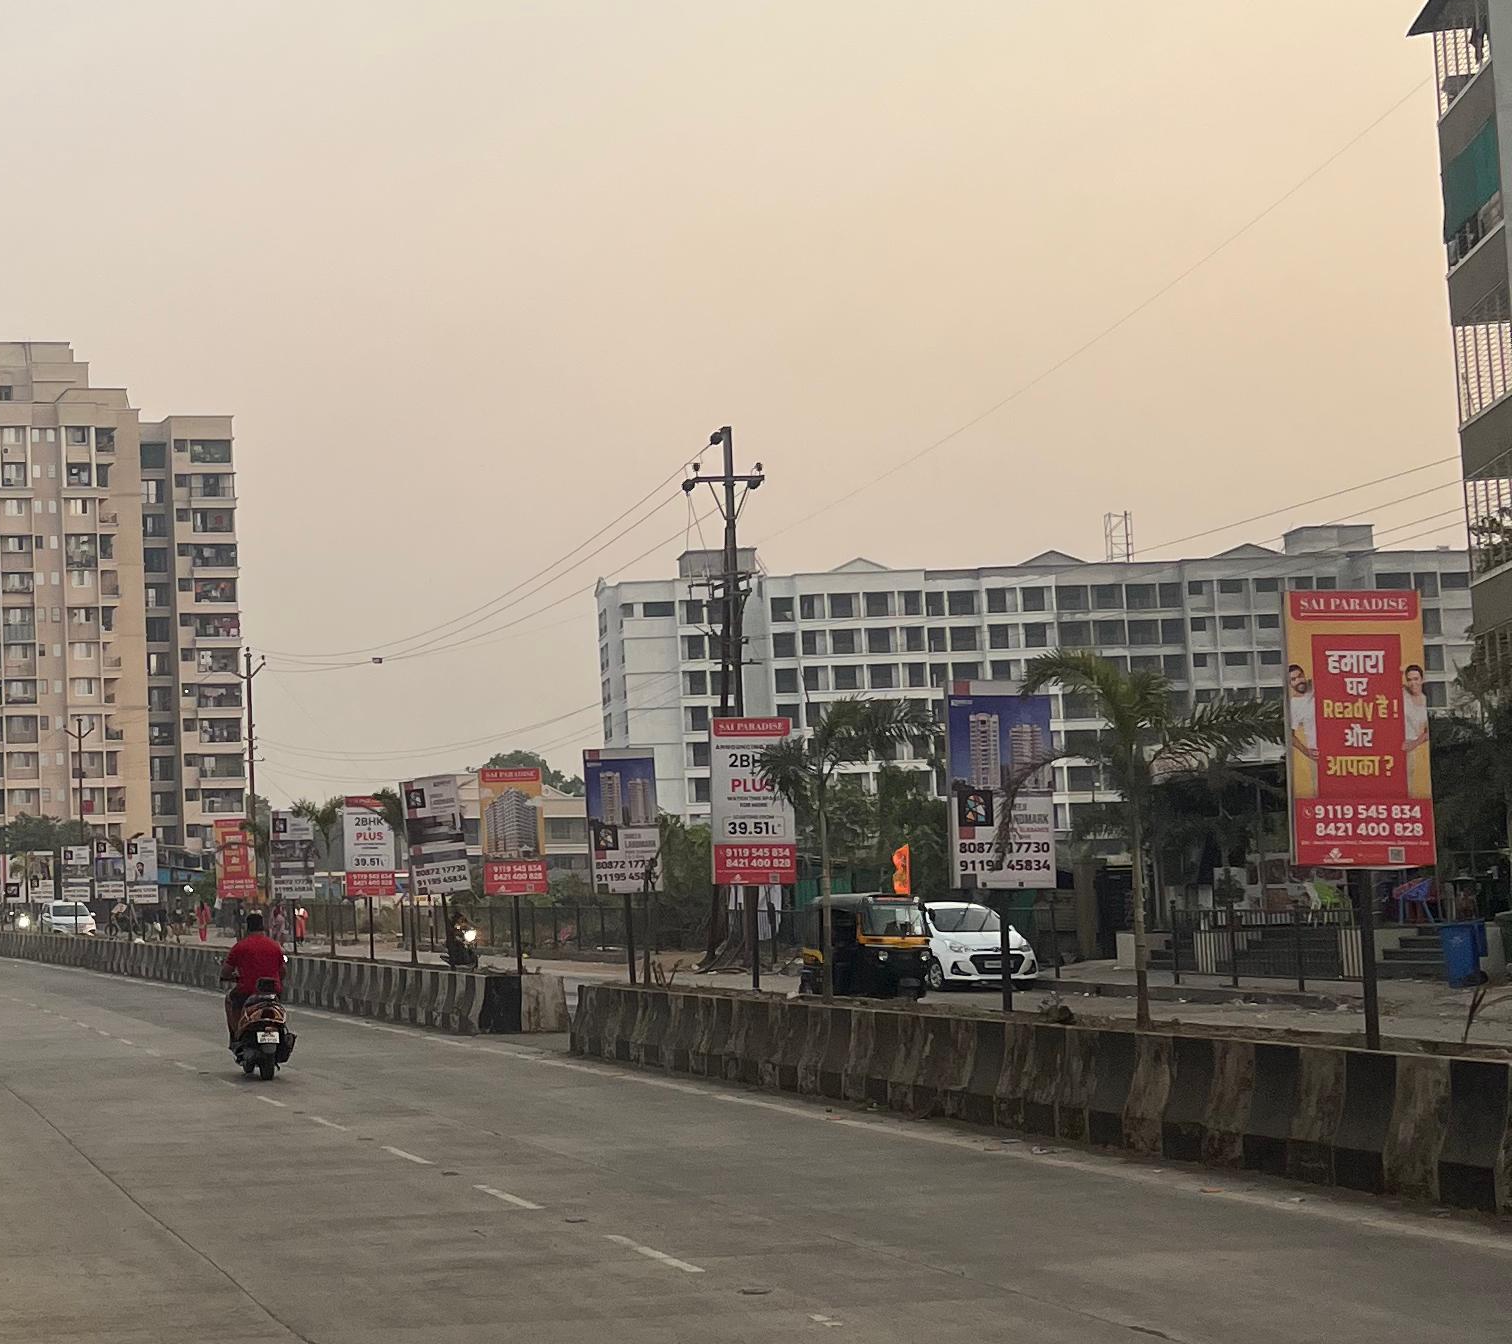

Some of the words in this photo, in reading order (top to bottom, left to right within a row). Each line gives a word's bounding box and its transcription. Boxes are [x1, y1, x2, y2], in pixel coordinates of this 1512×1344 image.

[1300, 598, 1325, 610] SAI
[1331, 598, 1408, 610] PARADISE
[1325, 650, 1386, 674] हमारा
[1344, 678, 1368, 696] घर
[1323, 699, 1374, 722] Ready
[718, 723, 736, 731] SAI
[737, 722, 785, 731] PARADISE
[1344, 723, 1374, 747] और
[1326, 756, 1381, 776] आपका
[731, 778, 776, 793] PLUS
[1314, 805, 1354, 819] 9119
[1357, 805, 1388, 819] 545
[1391, 805, 1421, 819] 834
[354, 817, 385, 827] 2BHK
[1315, 822, 1353, 836] 8421
[1356, 822, 1390, 836] 400
[1394, 822, 1424, 836] 828
[355, 831, 384, 841] PLUS
[725, 848, 749, 857] 9119
[751, 848, 770, 857] 545
[771, 848, 791, 857] 834
[726, 858, 749, 867] 8421
[750, 858, 771, 867] 400
[1006, 859, 1051, 872] 45834
